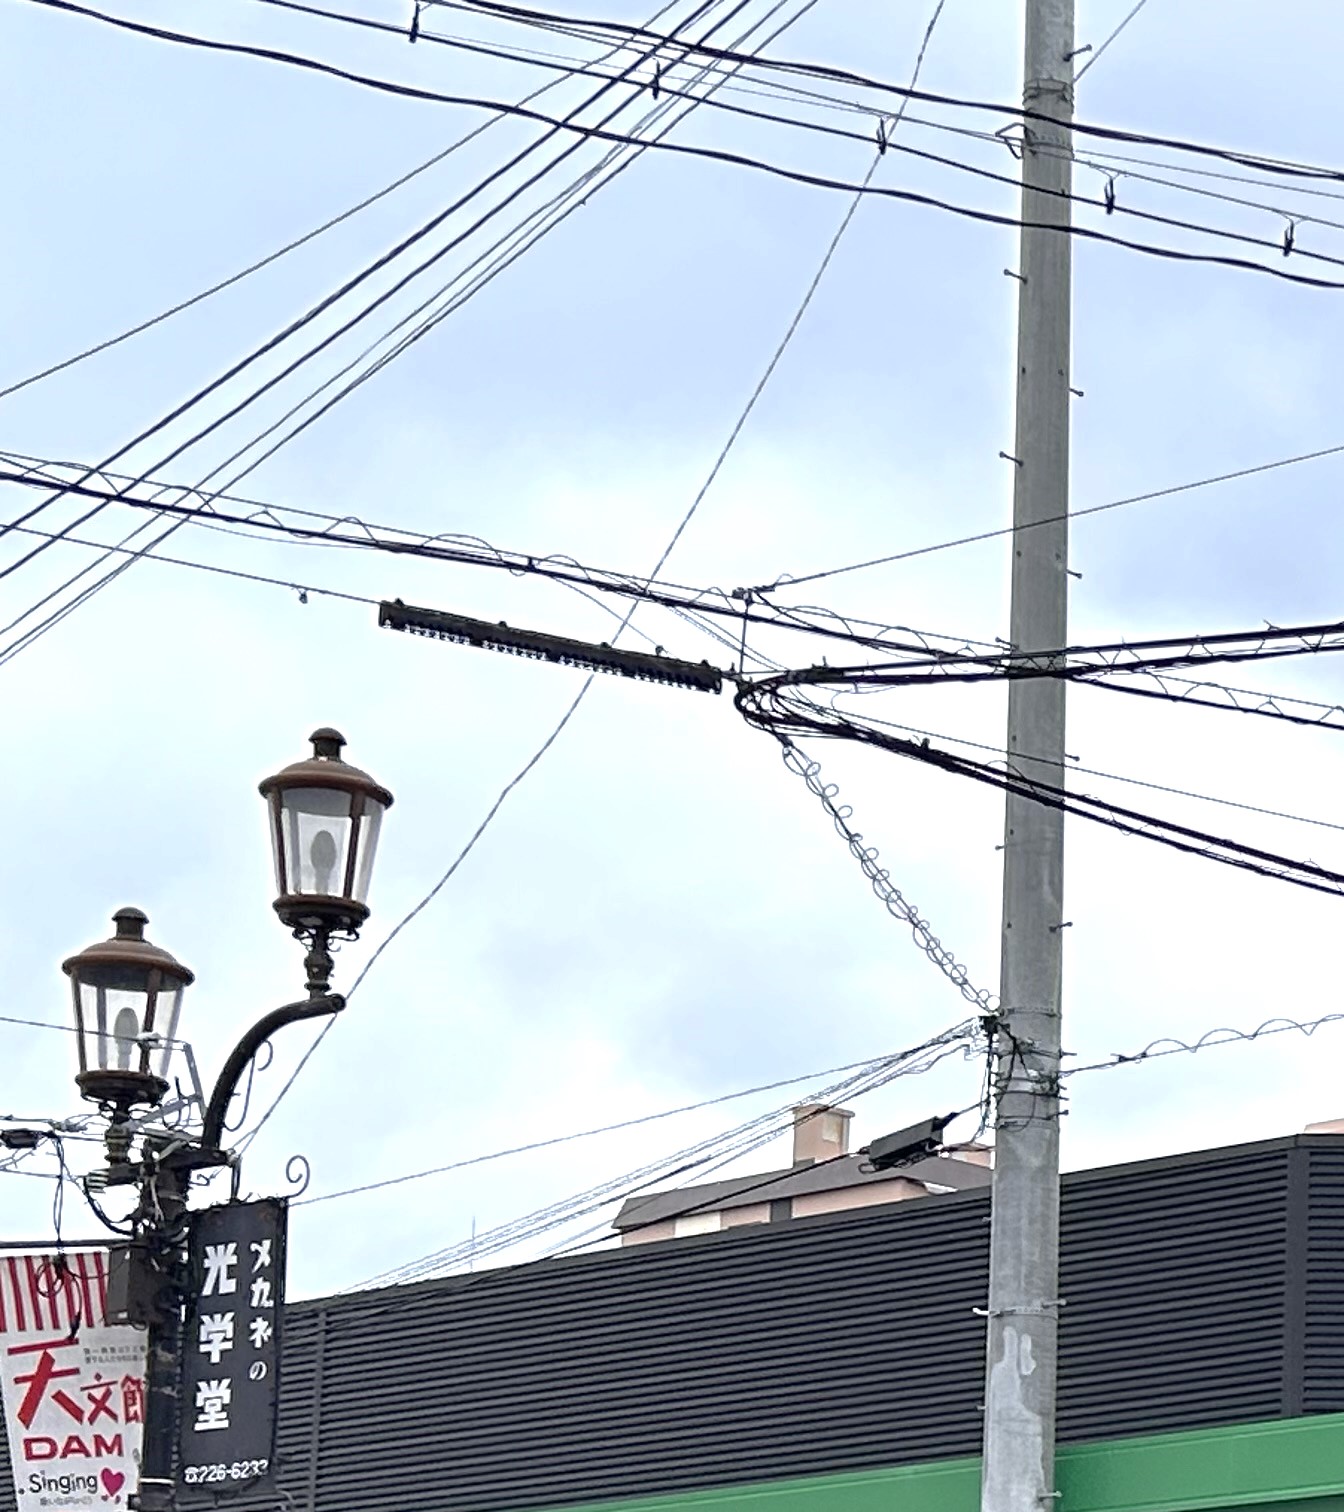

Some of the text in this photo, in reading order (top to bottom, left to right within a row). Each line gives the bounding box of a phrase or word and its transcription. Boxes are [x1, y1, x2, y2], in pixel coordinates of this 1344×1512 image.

[194, 1241, 239, 1432] 光学堂
[23, 1433, 124, 1461] DAM
[28, 1470, 98, 1493] Singing
